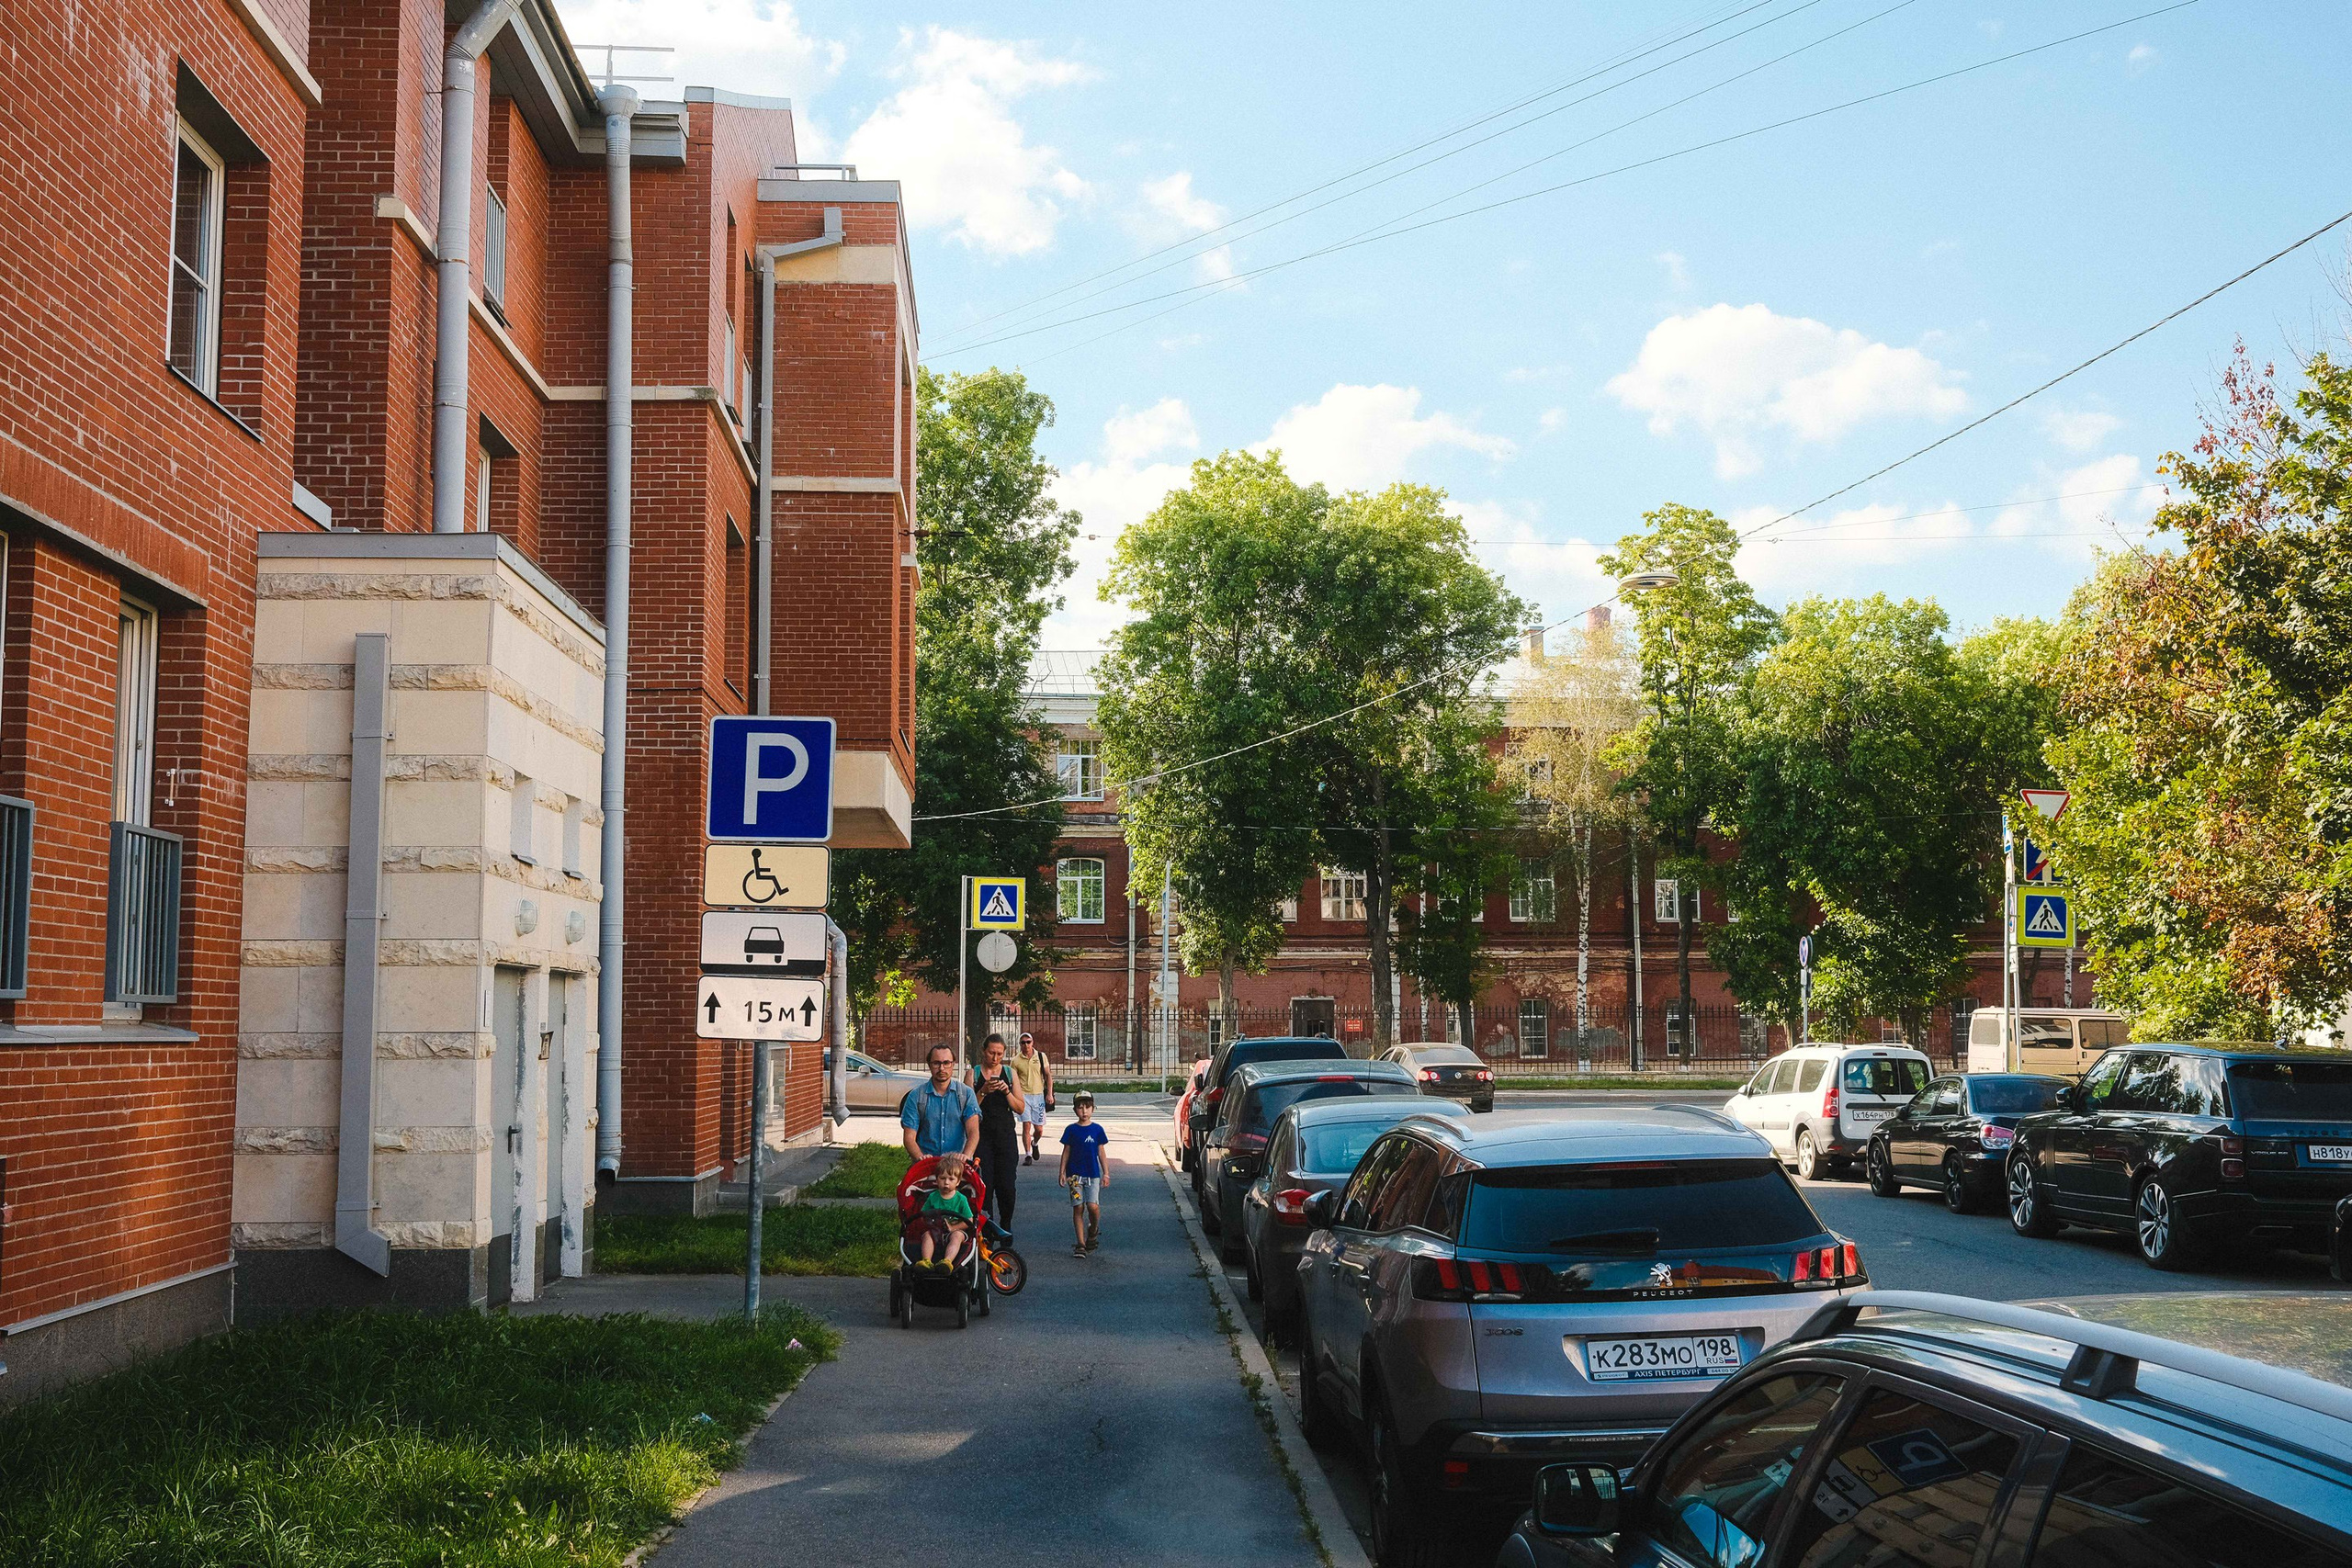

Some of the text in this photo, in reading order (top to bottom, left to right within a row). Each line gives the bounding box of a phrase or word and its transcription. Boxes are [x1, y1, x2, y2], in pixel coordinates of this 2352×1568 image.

[743, 732, 809, 825] P
[2313, 1147, 2352, 1159] Н818У
[1633, 1289, 1693, 1297] PEUGEOT
[1596, 1338, 1732, 1369] К283МО 198
[1706, 1357, 1724, 1365] RUS
[1634, 1369, 1702, 1378] AXIS ПЕТЕРБУРГ
